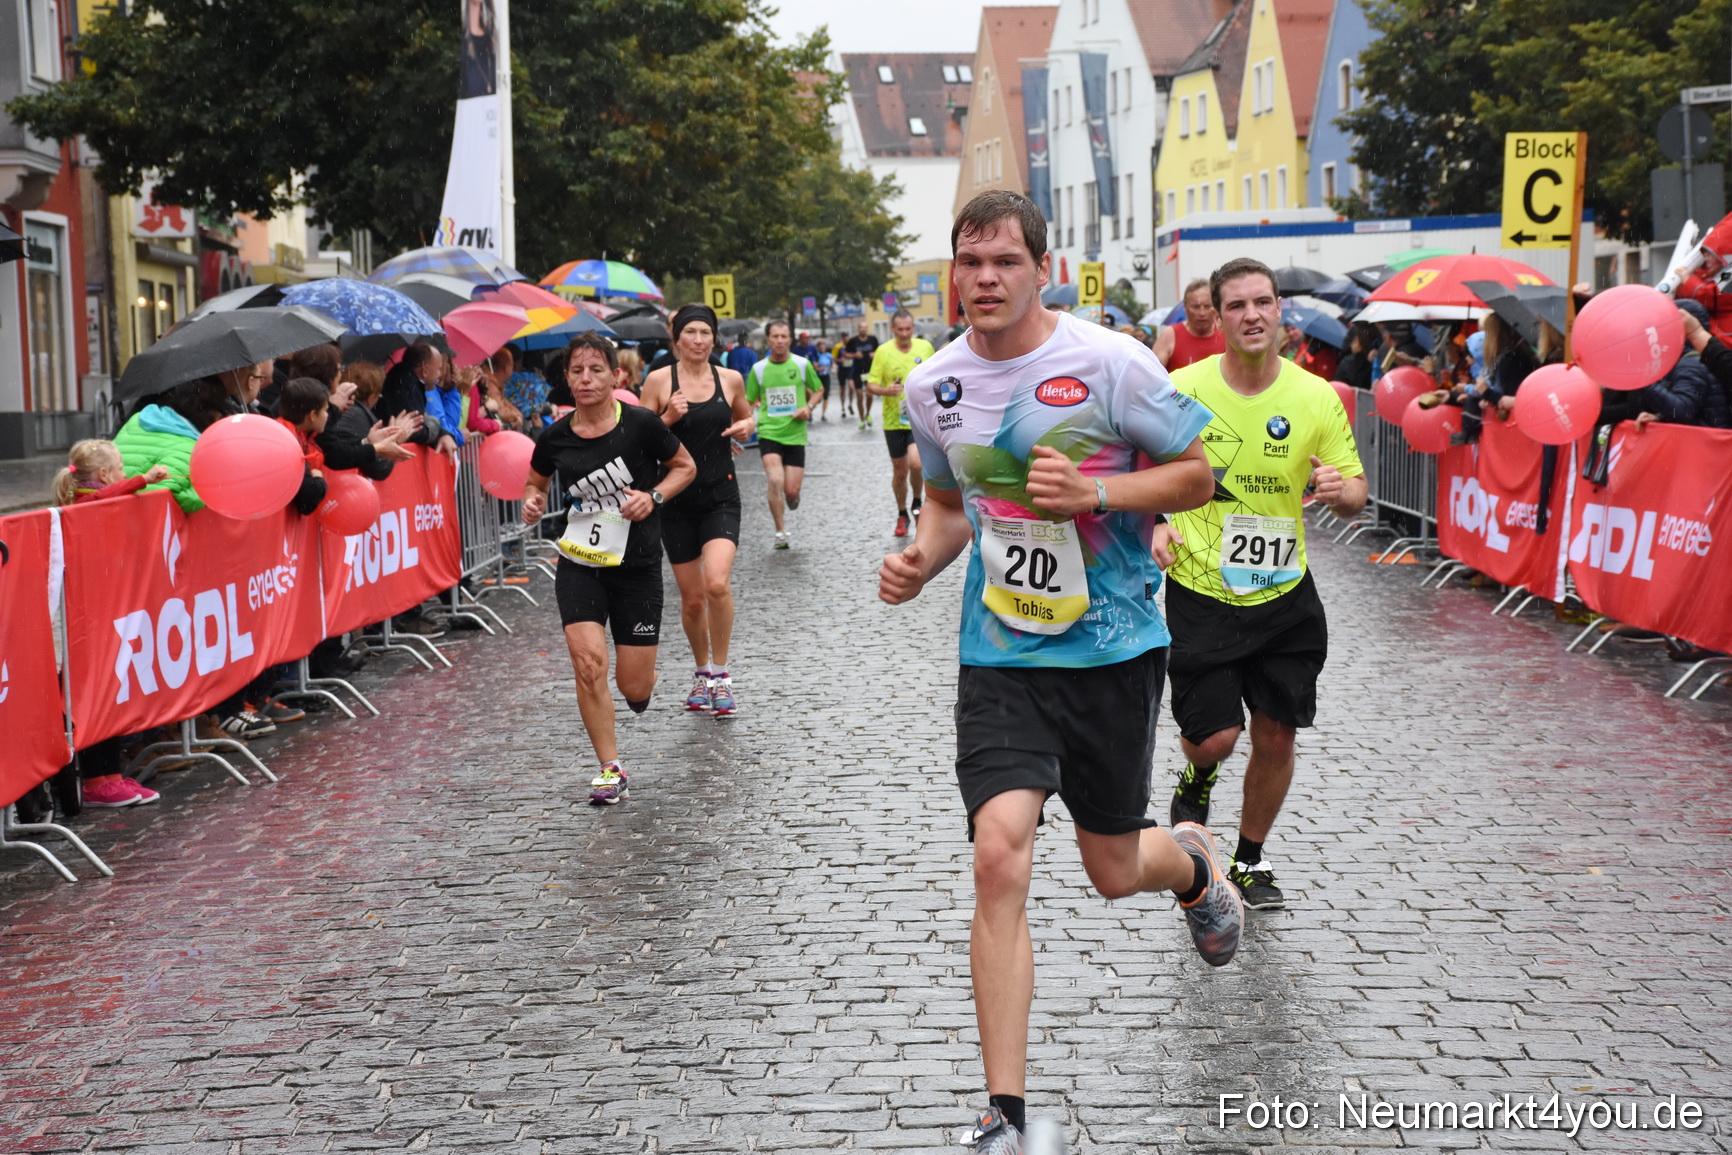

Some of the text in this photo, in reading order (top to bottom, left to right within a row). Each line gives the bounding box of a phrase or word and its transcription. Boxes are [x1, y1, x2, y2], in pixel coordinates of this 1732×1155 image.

[1515, 139, 1576, 158] Block
[1523, 168, 1562, 224] C
[1086, 276, 1098, 296] D
[713, 288, 727, 309] D
[770, 393, 795, 406] 2553
[1042, 384, 1083, 399] Hervis
[938, 412, 962, 425] PARTL
[939, 422, 963, 432] Neumarkt
[1264, 442, 1289, 453] Partl
[1235, 475, 1279, 485] THE NEXT
[1244, 485, 1290, 494] 100 YEARS
[588, 523, 602, 547] 5
[991, 527, 1026, 538] NeuerMarkt
[568, 544, 608, 564] Marianne
[1229, 534, 1297, 567] 2917
[1004, 544, 1062, 593] 202
[1251, 573, 1275, 586] Ralf
[1013, 597, 1055, 621] Tobias
